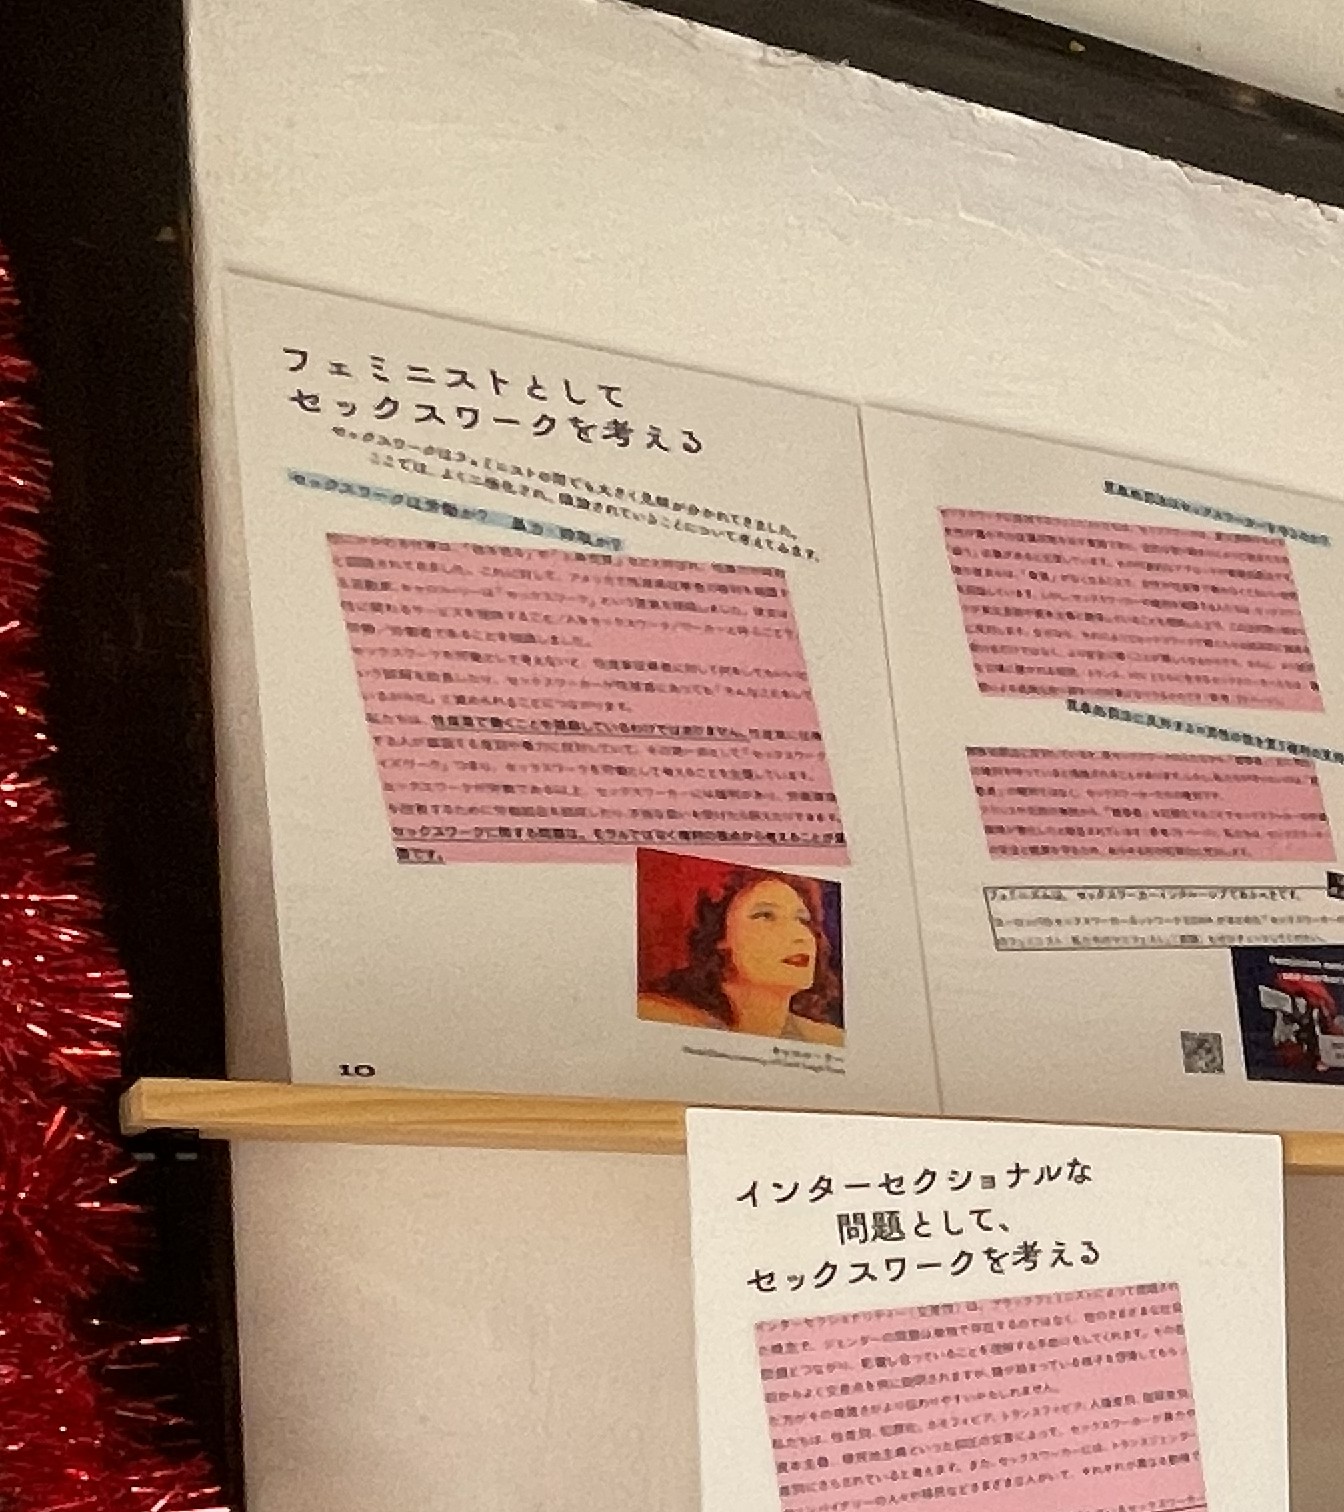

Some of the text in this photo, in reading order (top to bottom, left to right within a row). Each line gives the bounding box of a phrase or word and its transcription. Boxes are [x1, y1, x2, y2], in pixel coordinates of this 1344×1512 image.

[282, 347, 626, 408] フェミニストとして
[290, 390, 705, 455] セックスワークを考える
[338, 1063, 376, 1078] 10
[736, 1157, 1095, 1207] インターセクショナルな
[836, 1206, 1010, 1246] 問題として、
[747, 1240, 1101, 1293] セックスワークを考える
